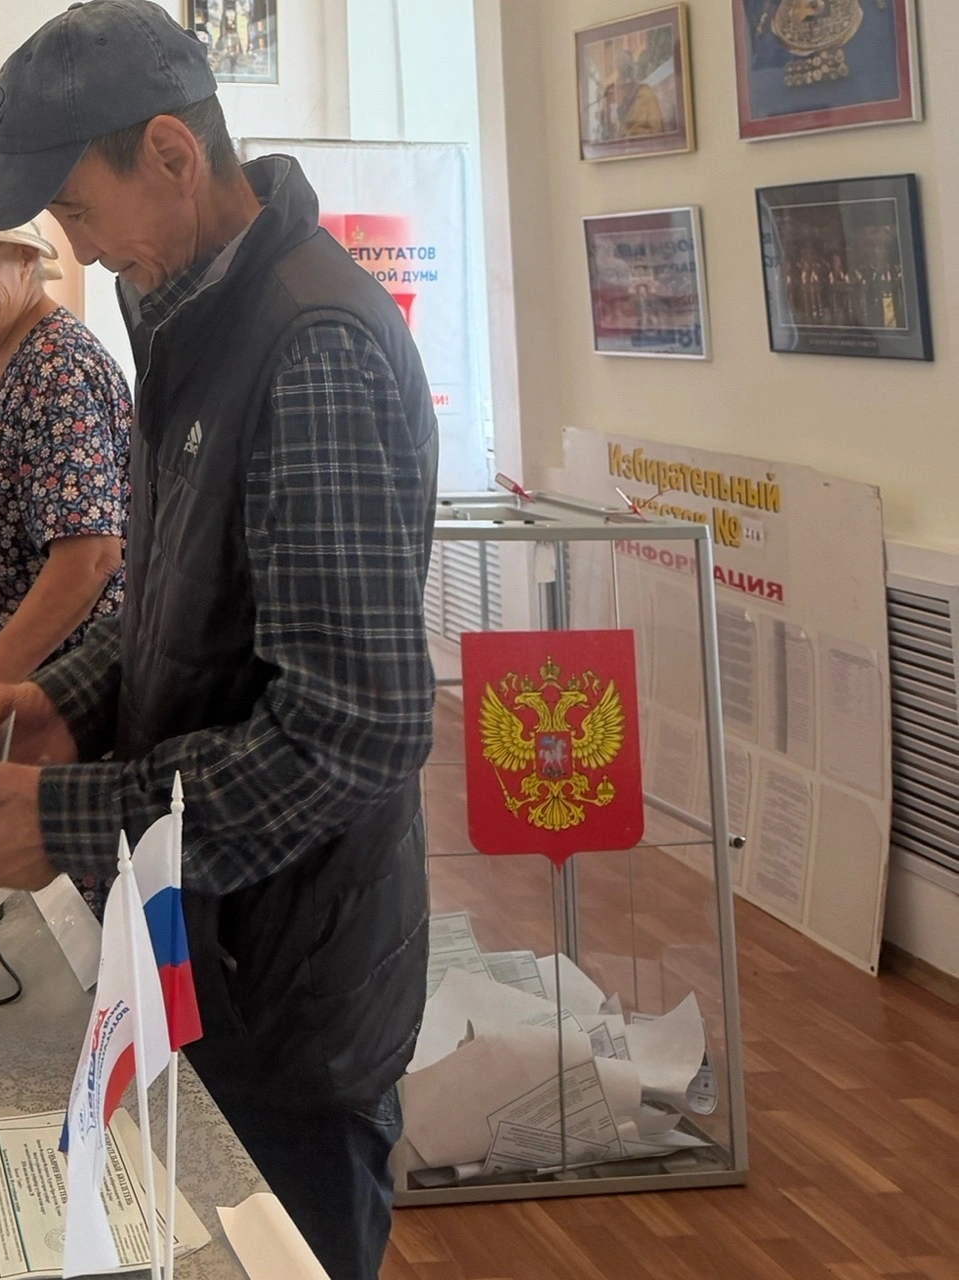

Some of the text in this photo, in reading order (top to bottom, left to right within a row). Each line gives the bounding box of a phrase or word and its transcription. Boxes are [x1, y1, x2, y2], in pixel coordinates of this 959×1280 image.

[348, 246, 437, 261] ЕПУТАТОВ
[401, 270, 438, 283] ДУМЫ
[608, 441, 783, 513] Избирательный
[712, 506, 742, 549] №
[615, 540, 785, 602] ИНФОРАЦИЯ
